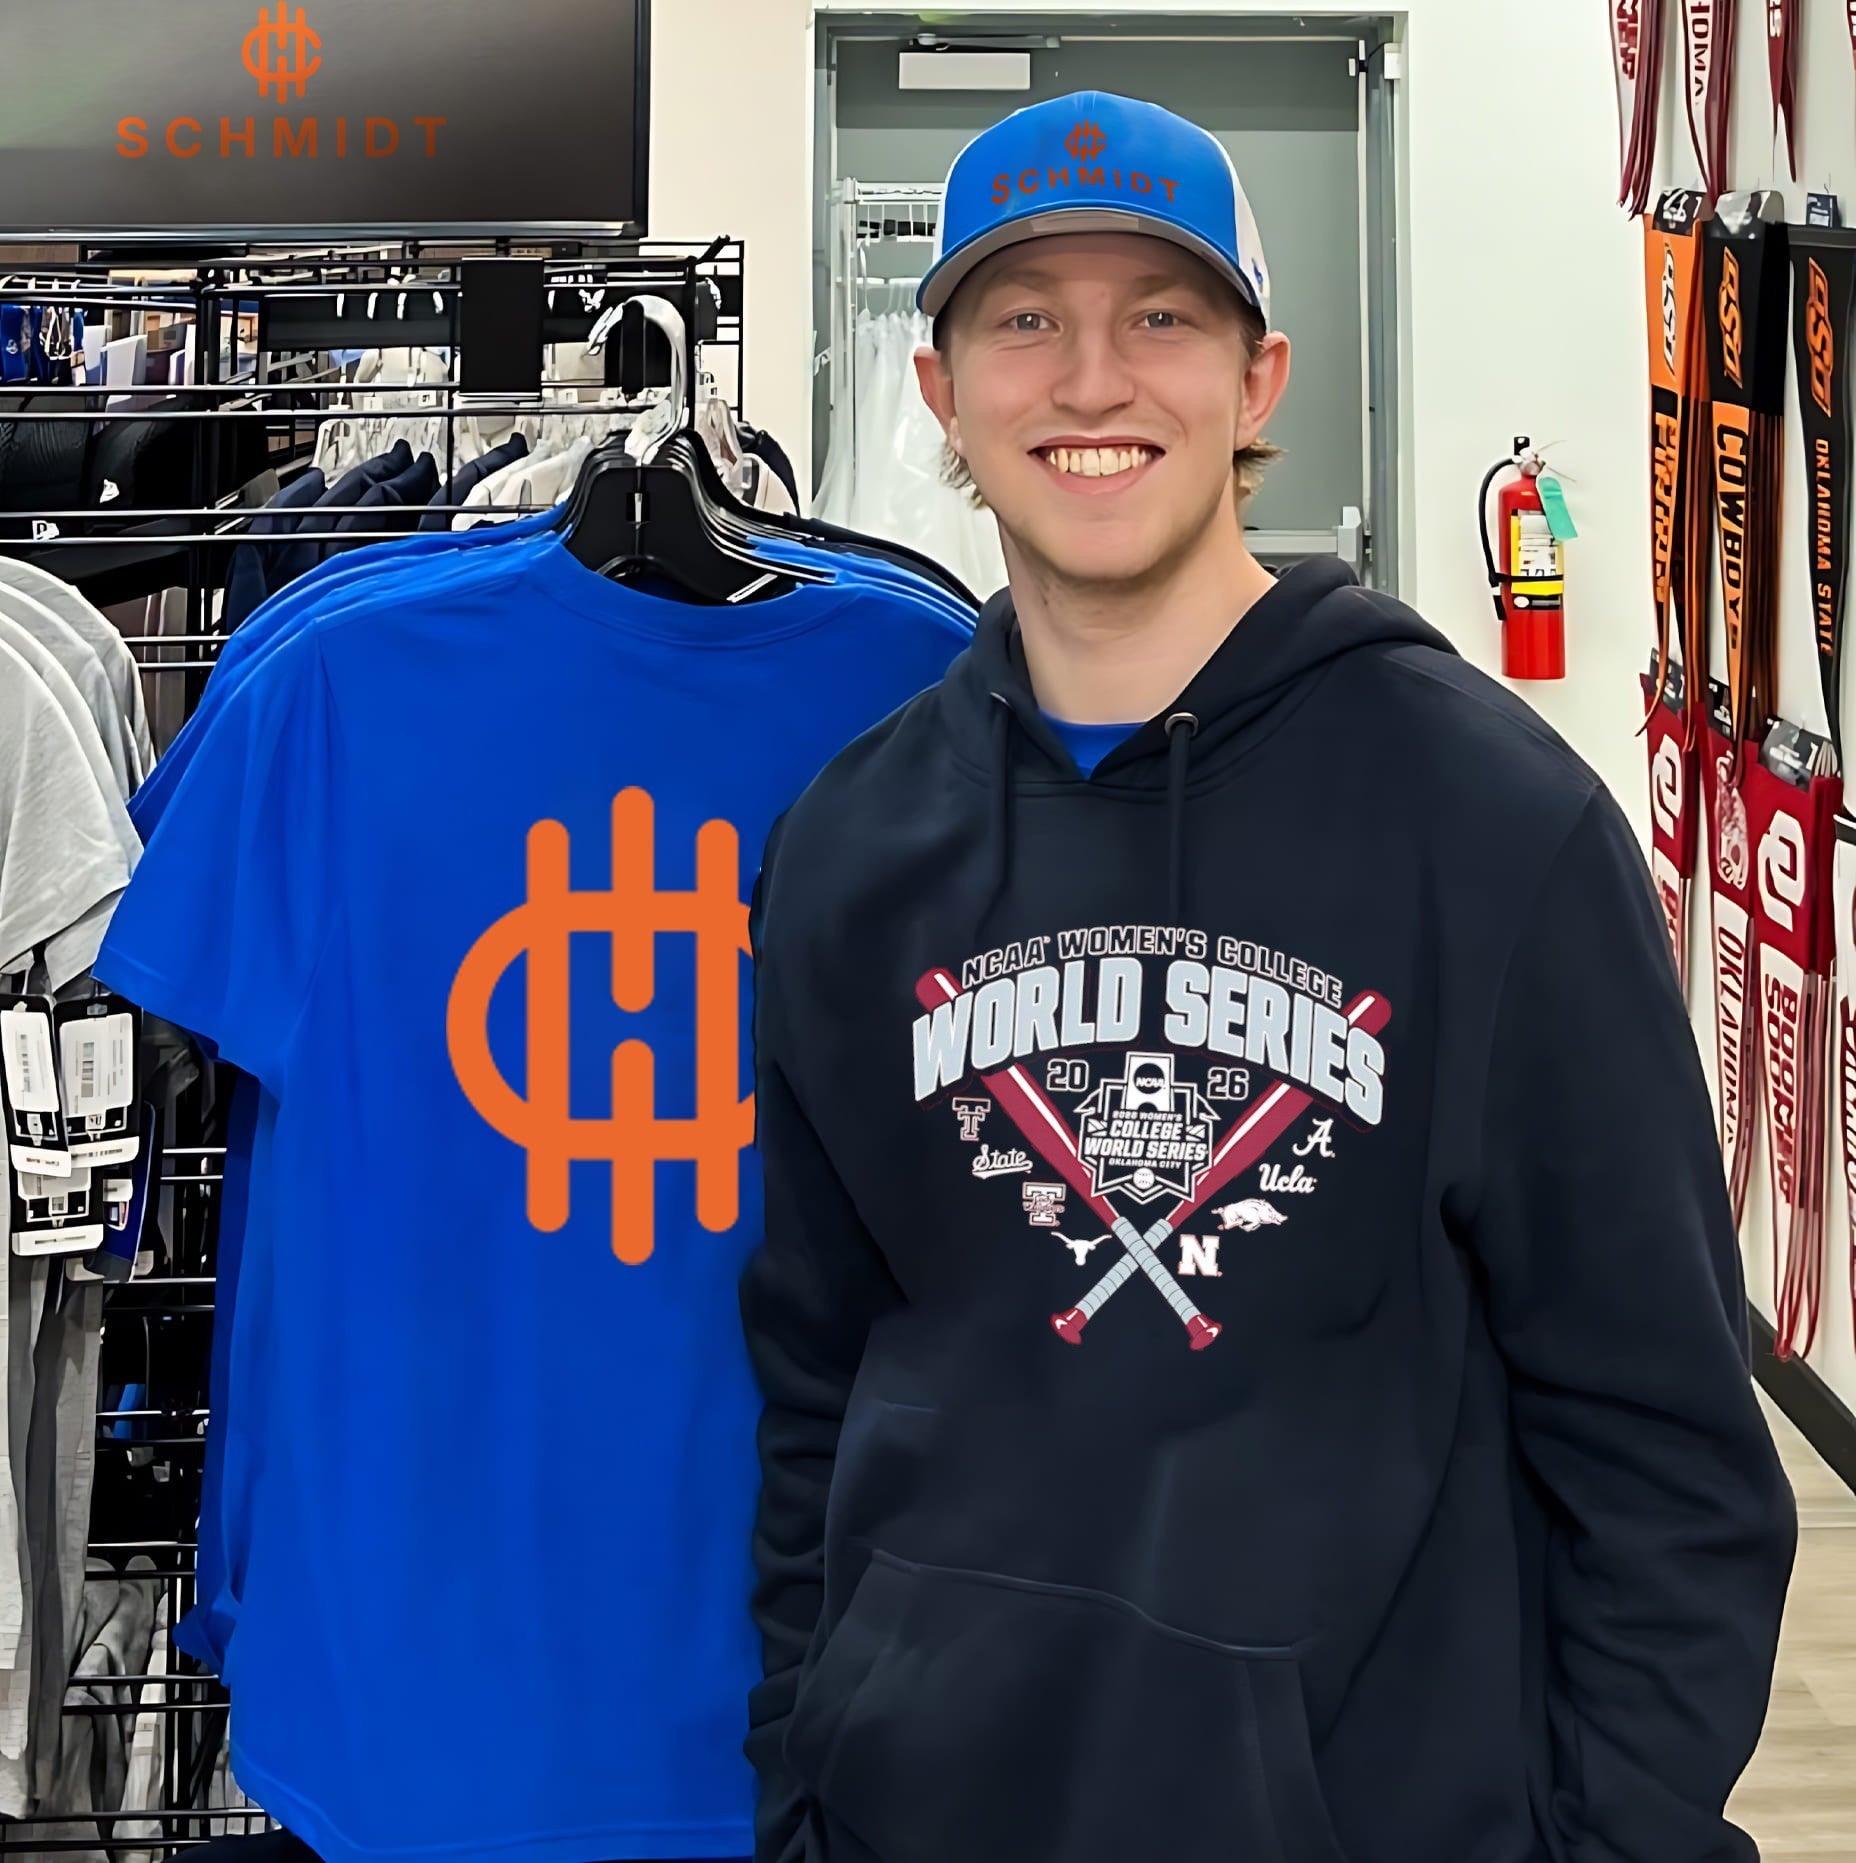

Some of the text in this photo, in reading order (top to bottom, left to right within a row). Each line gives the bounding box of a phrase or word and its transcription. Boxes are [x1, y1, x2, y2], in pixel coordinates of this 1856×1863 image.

[116, 116, 448, 159] SCHMIDT
[991, 167, 1179, 204] SCHMIDT
[962, 926, 1343, 1009] NCAA WOMEN'S COLLEGE
[912, 957, 1385, 1125] WORLD SERIES
[1046, 1058, 1249, 1101] 20 26
[1135, 1077, 1166, 1088] NCAA
[1109, 1119, 1184, 1140] COLLEGE
[1139, 1111, 1183, 1122] WOMEN'S
[1084, 1137, 1208, 1161] WORLD SERIES
[1292, 1118, 1335, 1157] A
[972, 1143, 1033, 1179] State
[1108, 1158, 1182, 1169] OKLAHOMA CITY
[1178, 1233, 1221, 1277] N
